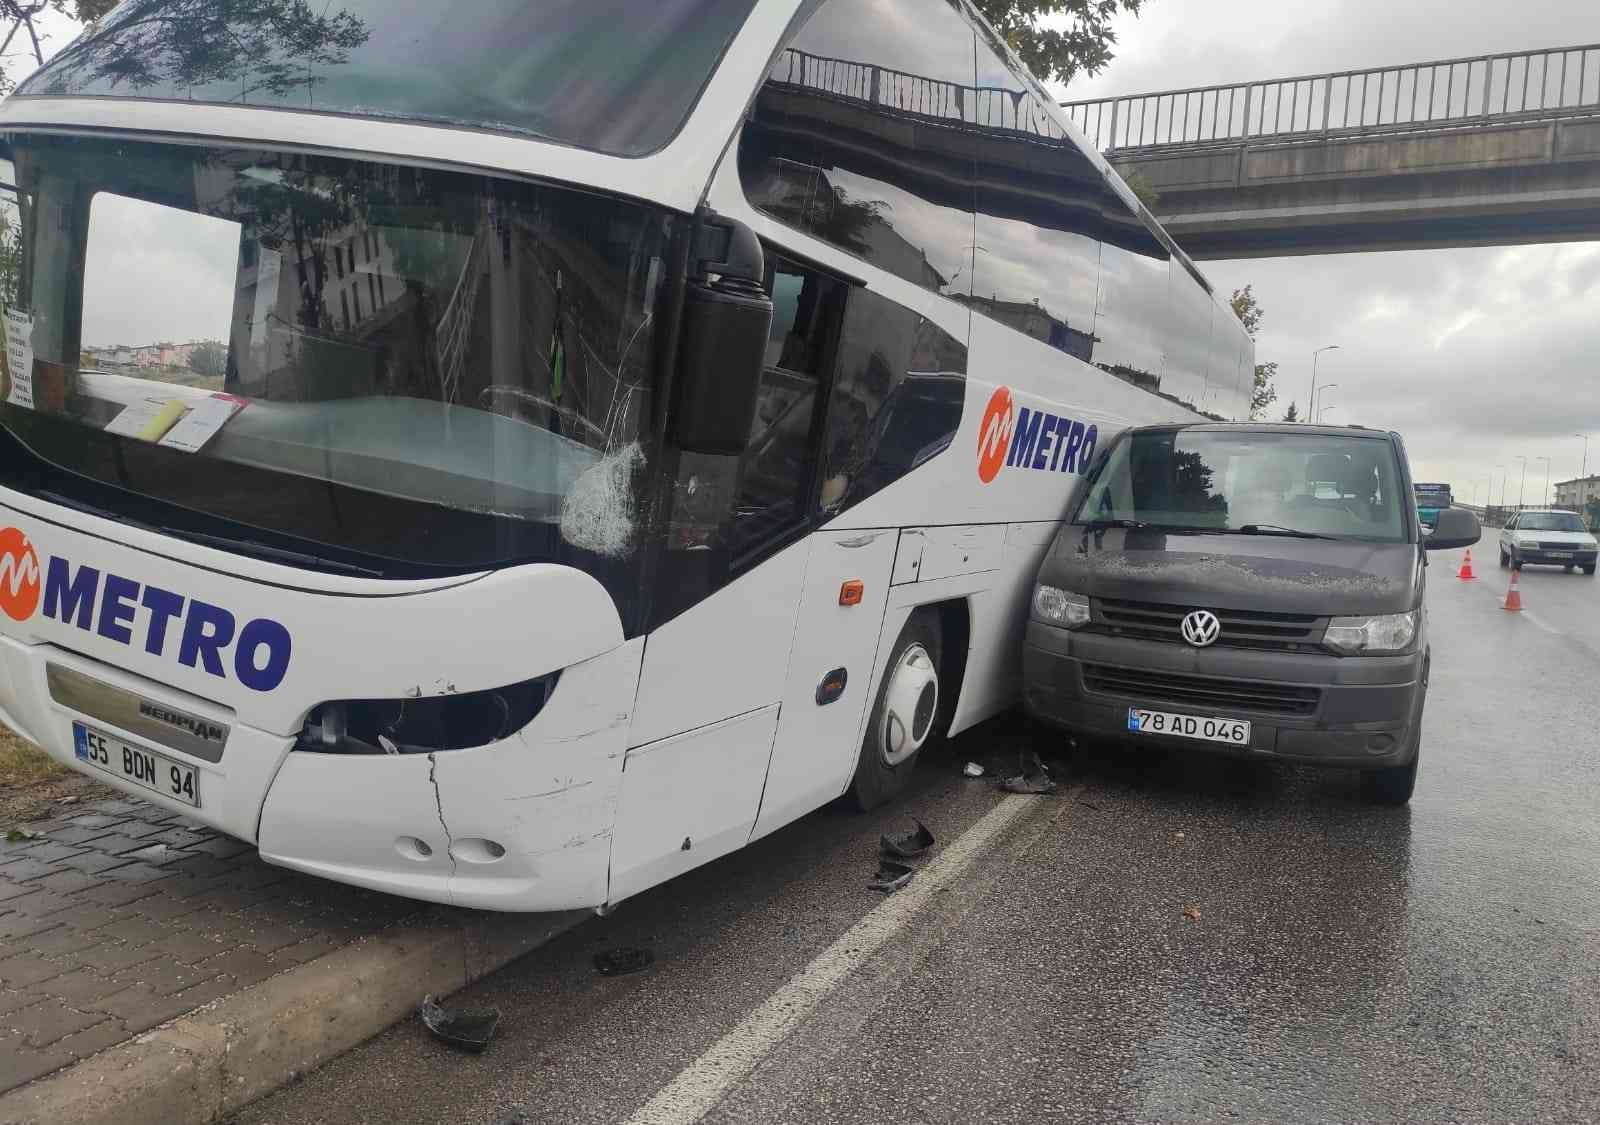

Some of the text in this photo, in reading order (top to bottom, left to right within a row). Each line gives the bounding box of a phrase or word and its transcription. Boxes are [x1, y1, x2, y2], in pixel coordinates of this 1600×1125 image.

[1006, 407, 1098, 476] METRO
[42, 555, 292, 692] METRO
[1140, 713, 1165, 730] 78
[1170, 716, 1198, 735] AD
[1203, 720, 1246, 741] 046
[88, 733, 108, 764] 55
[123, 746, 156, 784] BDN
[170, 766, 194, 798] 94
